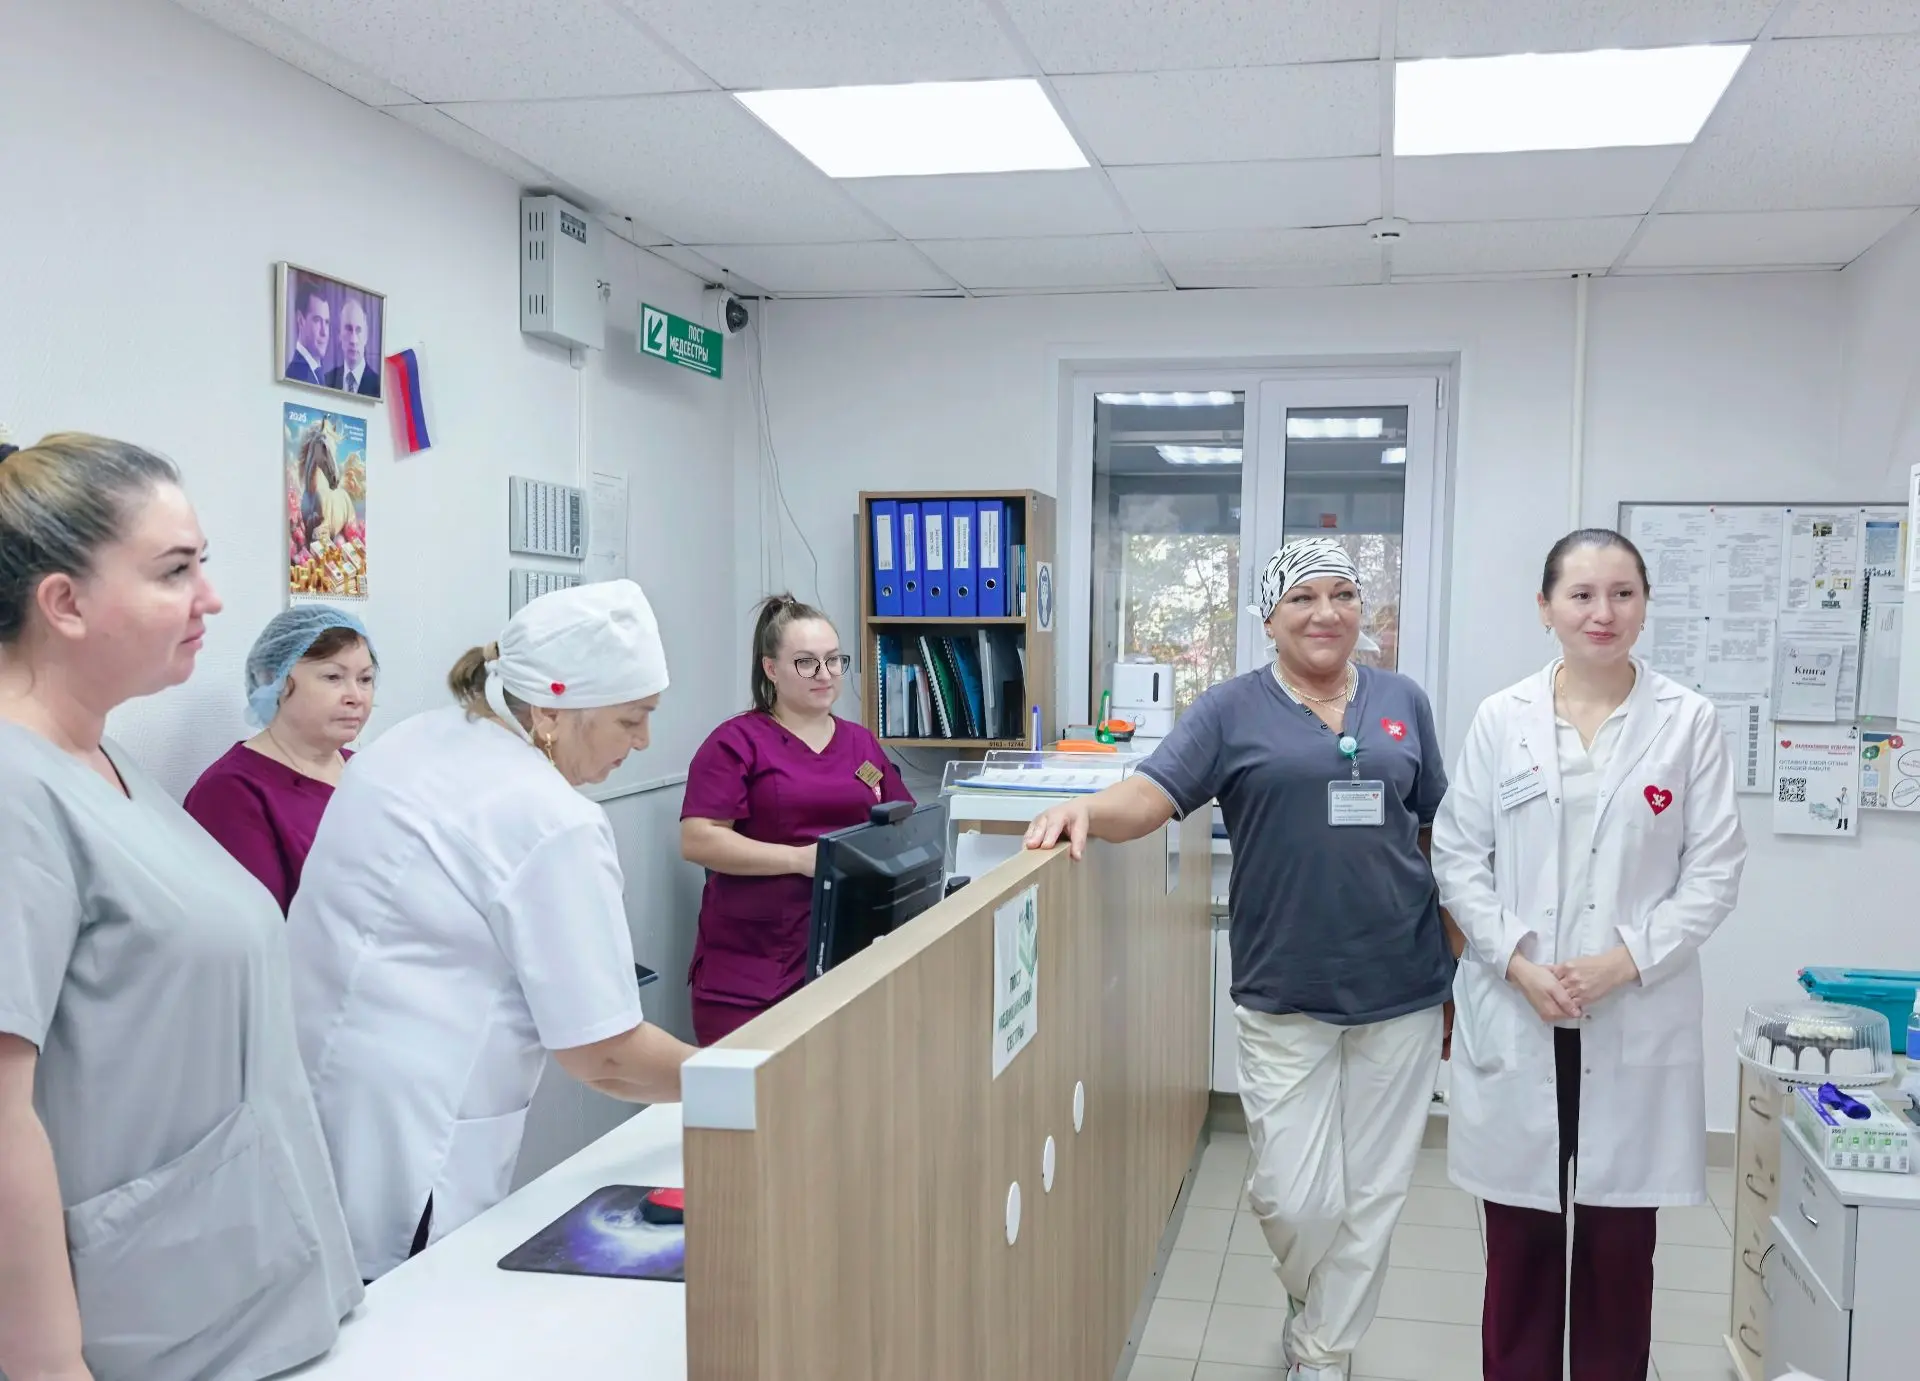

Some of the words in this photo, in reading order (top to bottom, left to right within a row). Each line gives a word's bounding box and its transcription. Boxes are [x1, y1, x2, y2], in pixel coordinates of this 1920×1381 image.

[688, 325, 704, 344] ПОСТ
[669, 335, 708, 362] МЕДСЕСТРЫ
[1794, 665, 1826, 676] Книга
